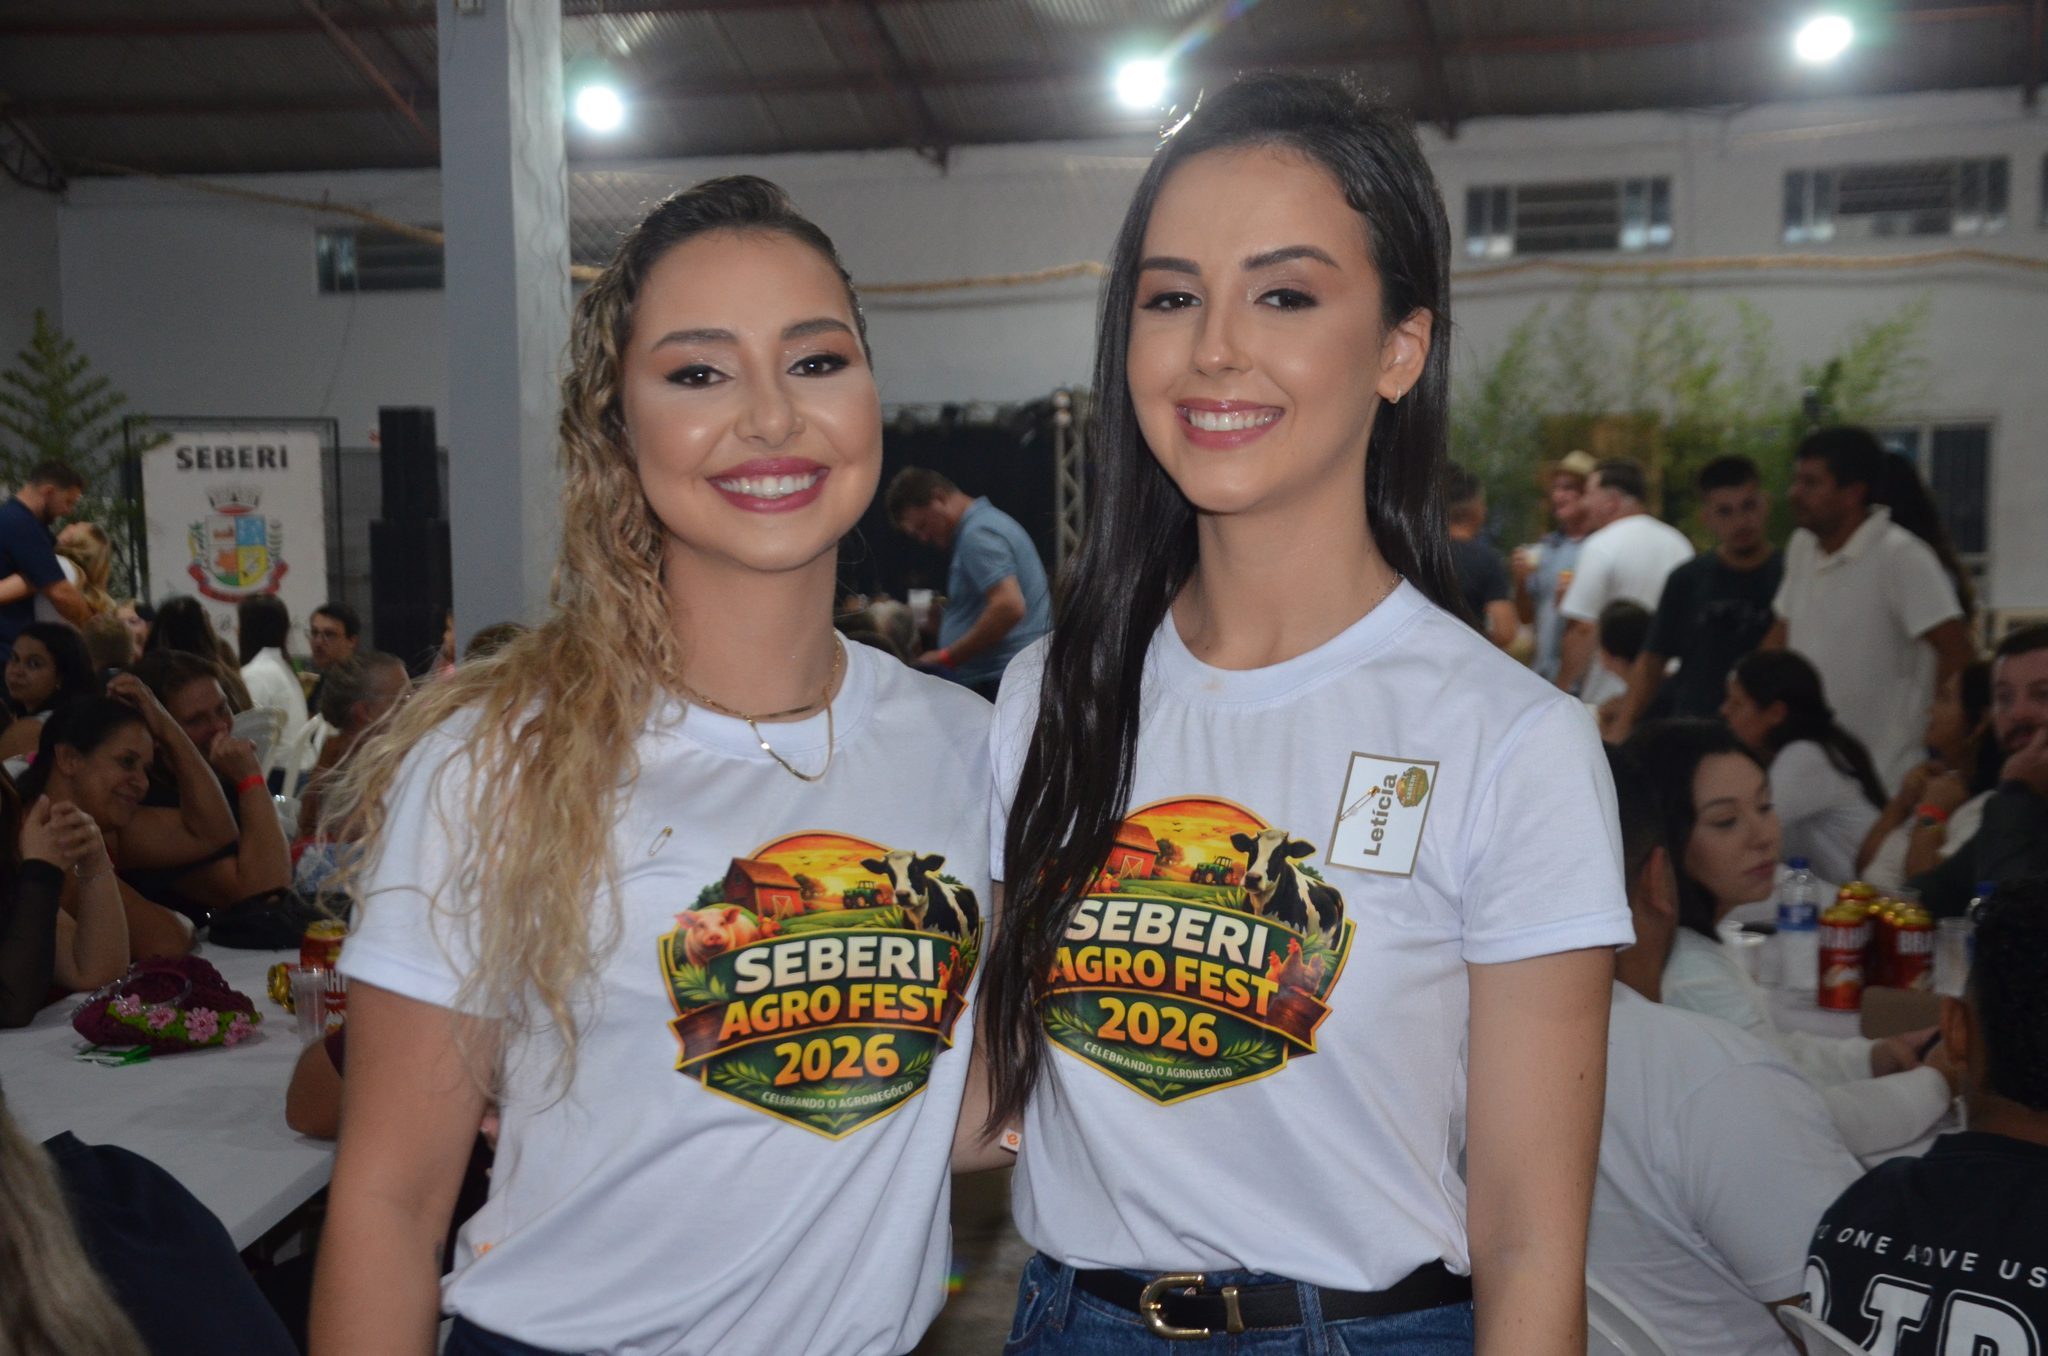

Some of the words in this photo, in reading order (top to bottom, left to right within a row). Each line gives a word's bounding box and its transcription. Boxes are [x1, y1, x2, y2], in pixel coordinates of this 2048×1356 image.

[175, 445, 288, 469] SEBERI
[1363, 774, 1398, 856] Letícia
[1064, 899, 1268, 970] SEBERI
[734, 936, 934, 994] SEBERI
[1048, 946, 1166, 987] AGRO
[1175, 955, 1279, 1016] FEST
[718, 985, 841, 1041] AGRO
[849, 984, 948, 1023] FEST
[1097, 996, 1219, 1057] 2026
[773, 1033, 900, 1086] 2026
[1084, 1041, 1153, 1074] CELEBRANDO
[1156, 1064, 1164, 1075] O
[1166, 1065, 1233, 1080] AGRONEGÓCIO
[761, 1090, 825, 1110] CELEBRANDO
[827, 1098, 836, 1110] O
[838, 1080, 914, 1109] AGRONEGÓCIO
[1837, 1227, 1893, 1254] ONE
[1999, 1258, 2048, 1288] US
